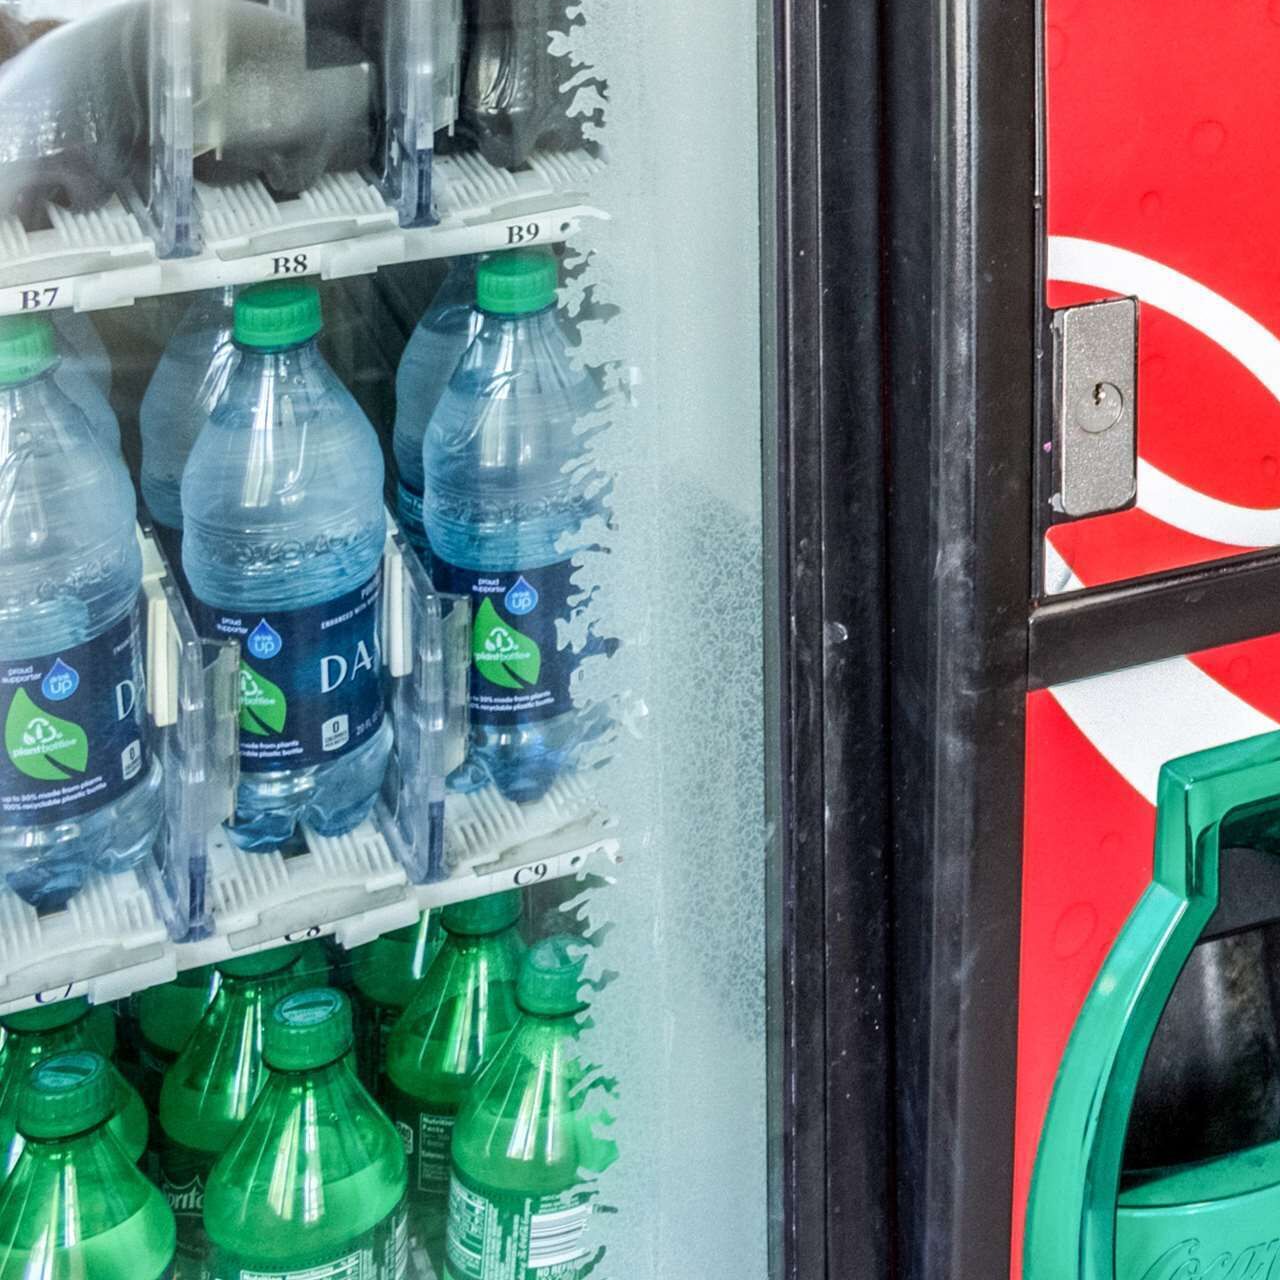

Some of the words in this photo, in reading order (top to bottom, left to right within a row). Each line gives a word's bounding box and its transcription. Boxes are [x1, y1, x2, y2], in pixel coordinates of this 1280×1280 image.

[505, 222, 540, 244] B9
[272, 253, 309, 274] B8
[20, 287, 59, 310] B7
[512, 862, 548, 886] C9
